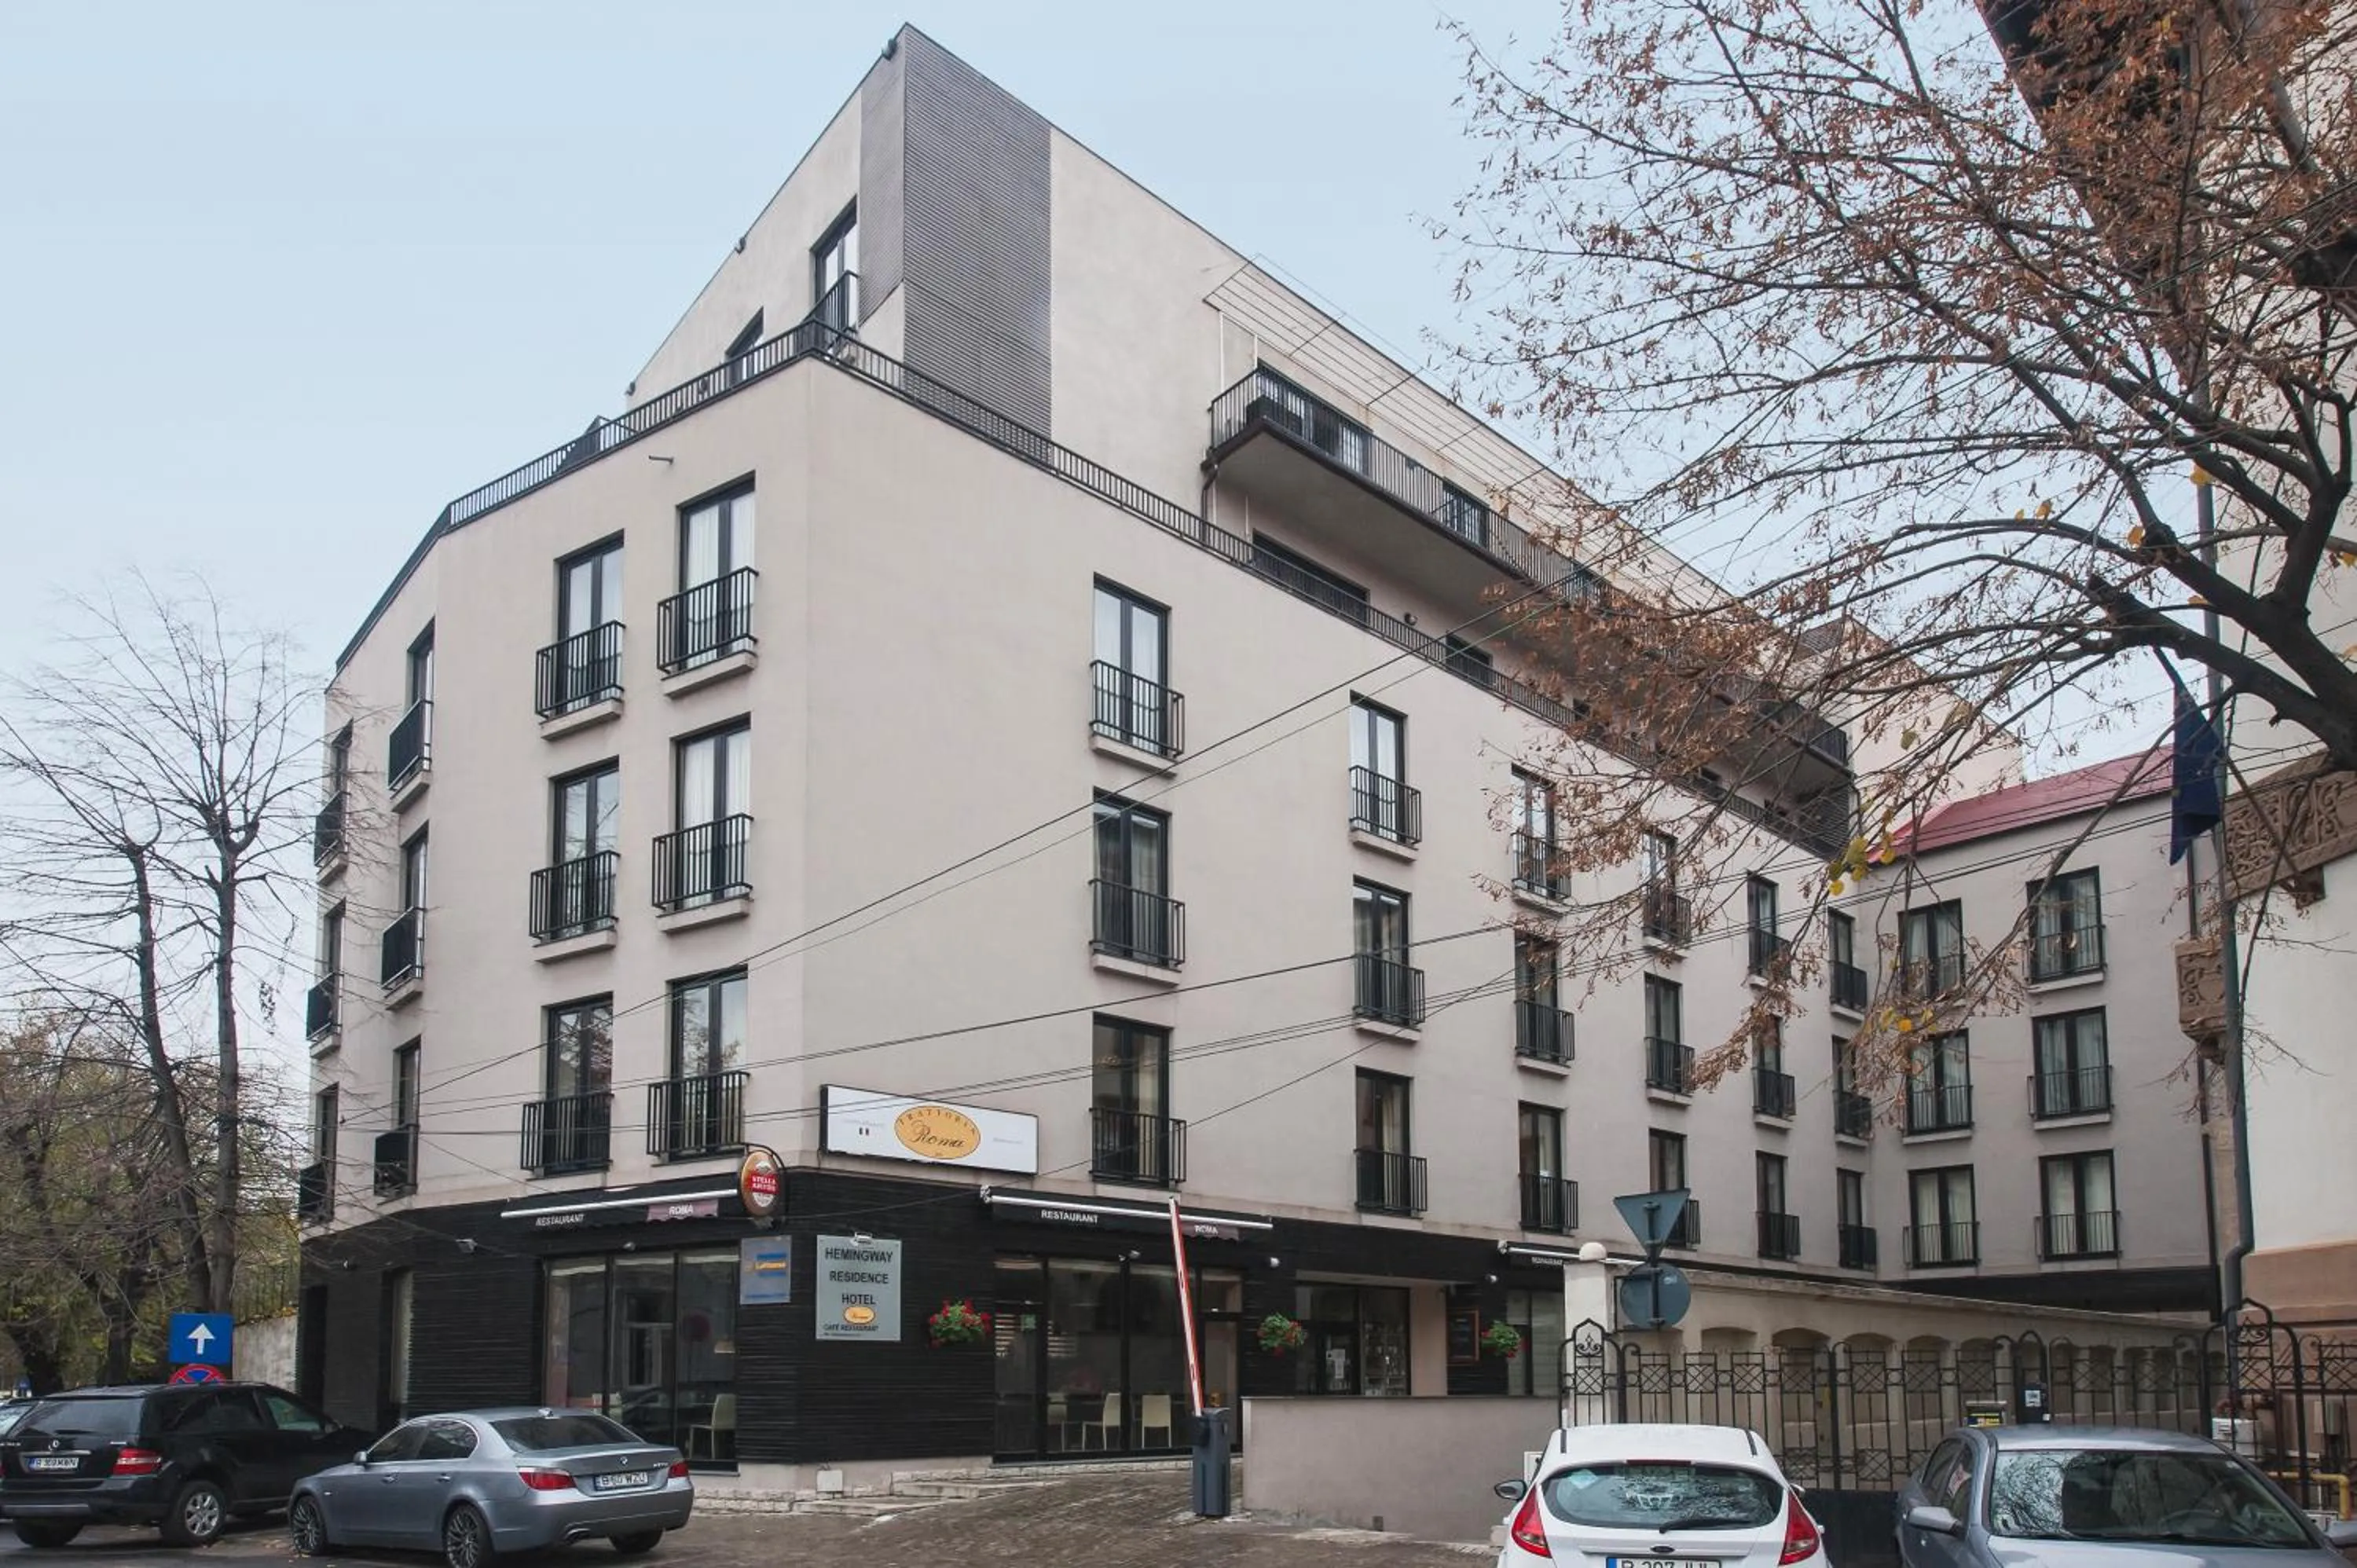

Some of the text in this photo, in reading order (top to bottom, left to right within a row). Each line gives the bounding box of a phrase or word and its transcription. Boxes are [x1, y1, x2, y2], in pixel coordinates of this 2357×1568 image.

[899, 1108, 975, 1136] TRATTORIA
[907, 1120, 966, 1148] Roma
[751, 1175, 775, 1185] STELLA
[535, 1204, 693, 1226] RESTAURANT ROMA
[1041, 1210, 1218, 1234] RESTAURANT ROMA
[825, 1247, 893, 1263] HEMINGWAY
[830, 1270, 889, 1284] RESIDENCE
[841, 1293, 877, 1305] HOTEL
